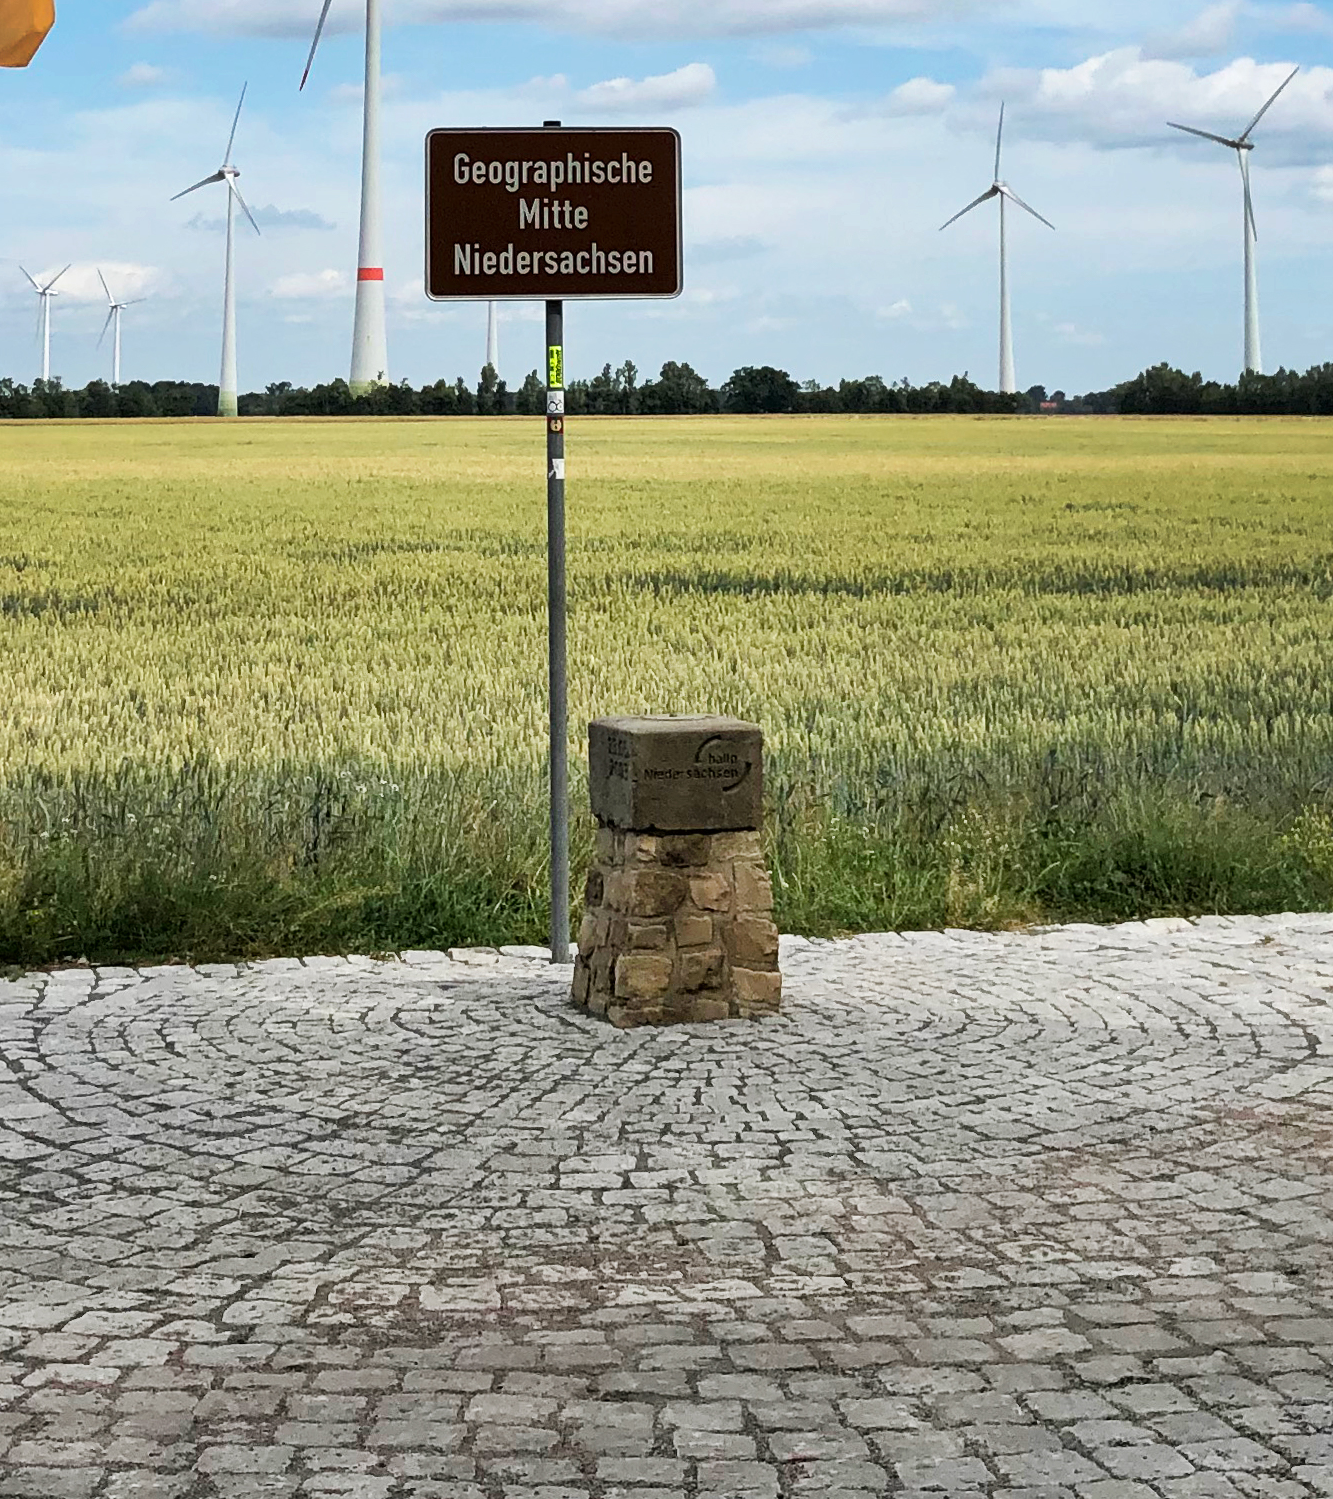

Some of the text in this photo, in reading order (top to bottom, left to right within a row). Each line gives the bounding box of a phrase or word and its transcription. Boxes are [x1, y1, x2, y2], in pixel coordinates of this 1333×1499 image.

[453, 152, 653, 192] Geographische
[519, 198, 589, 229] Mitte
[453, 242, 654, 275] Niedersachsen
[643, 766, 739, 780] Niedersachsen
